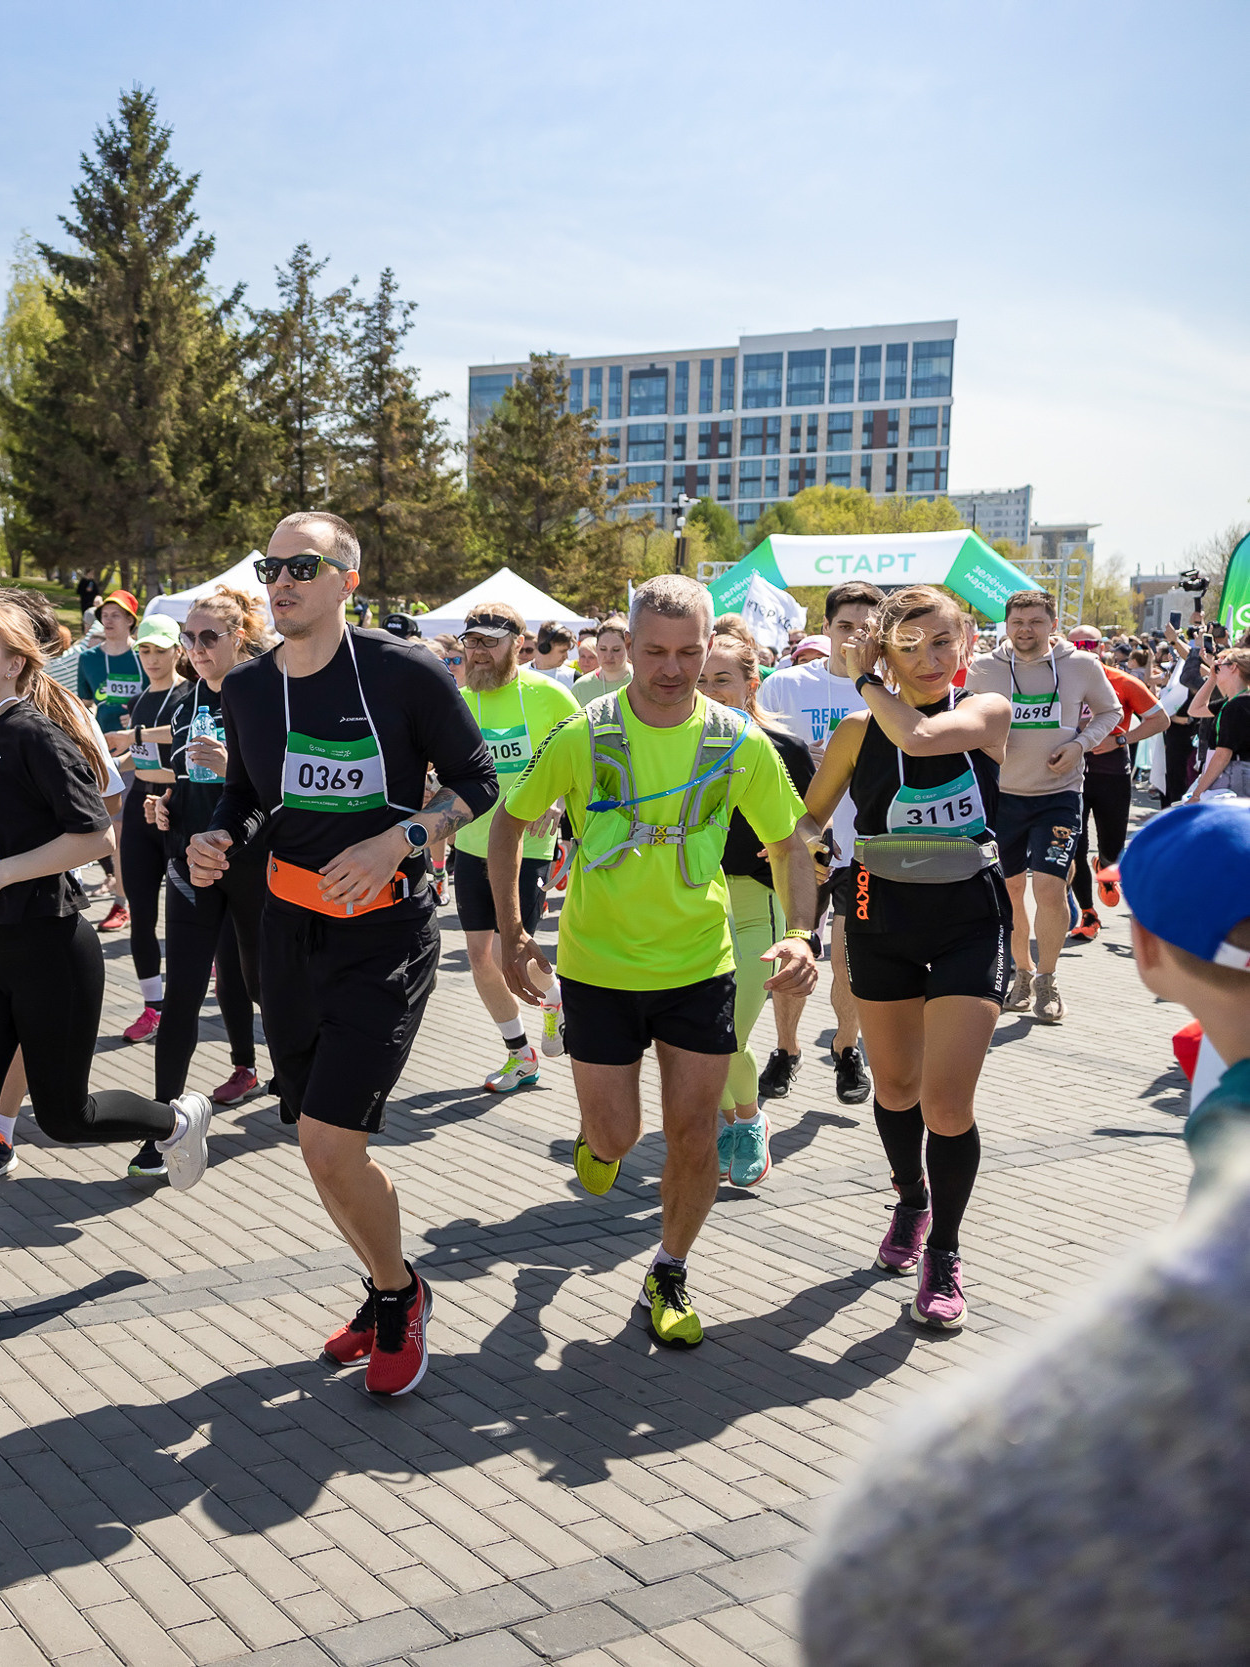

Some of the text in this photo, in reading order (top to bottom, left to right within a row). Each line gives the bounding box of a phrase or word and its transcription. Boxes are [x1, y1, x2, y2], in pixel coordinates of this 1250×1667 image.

[814, 553, 917, 574] СТАРТ
[111, 683, 137, 694] 0312
[1014, 706, 1052, 720] 0698
[486, 742, 522, 760] 105
[298, 763, 364, 791] 0369
[906, 795, 974, 825] 3115
